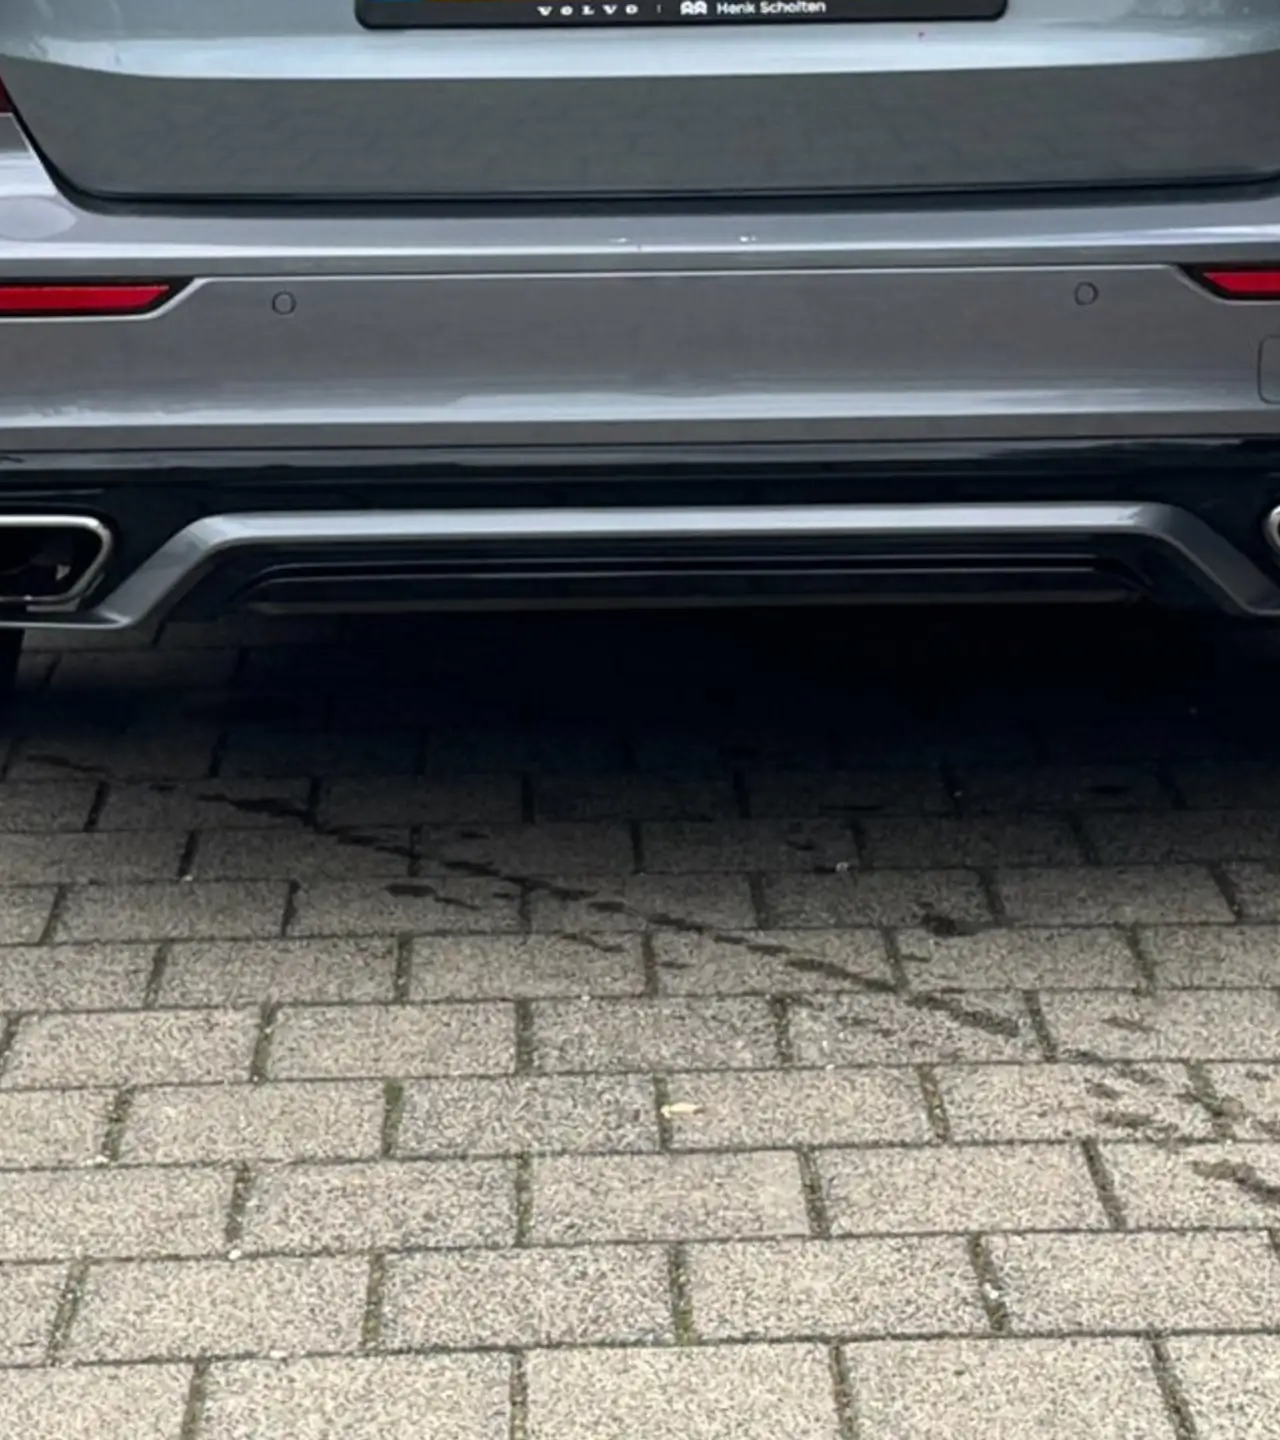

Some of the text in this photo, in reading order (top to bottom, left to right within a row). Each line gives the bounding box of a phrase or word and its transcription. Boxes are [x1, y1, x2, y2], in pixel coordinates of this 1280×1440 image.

[537, 0, 828, 16] VOLVO Henk Scholten
